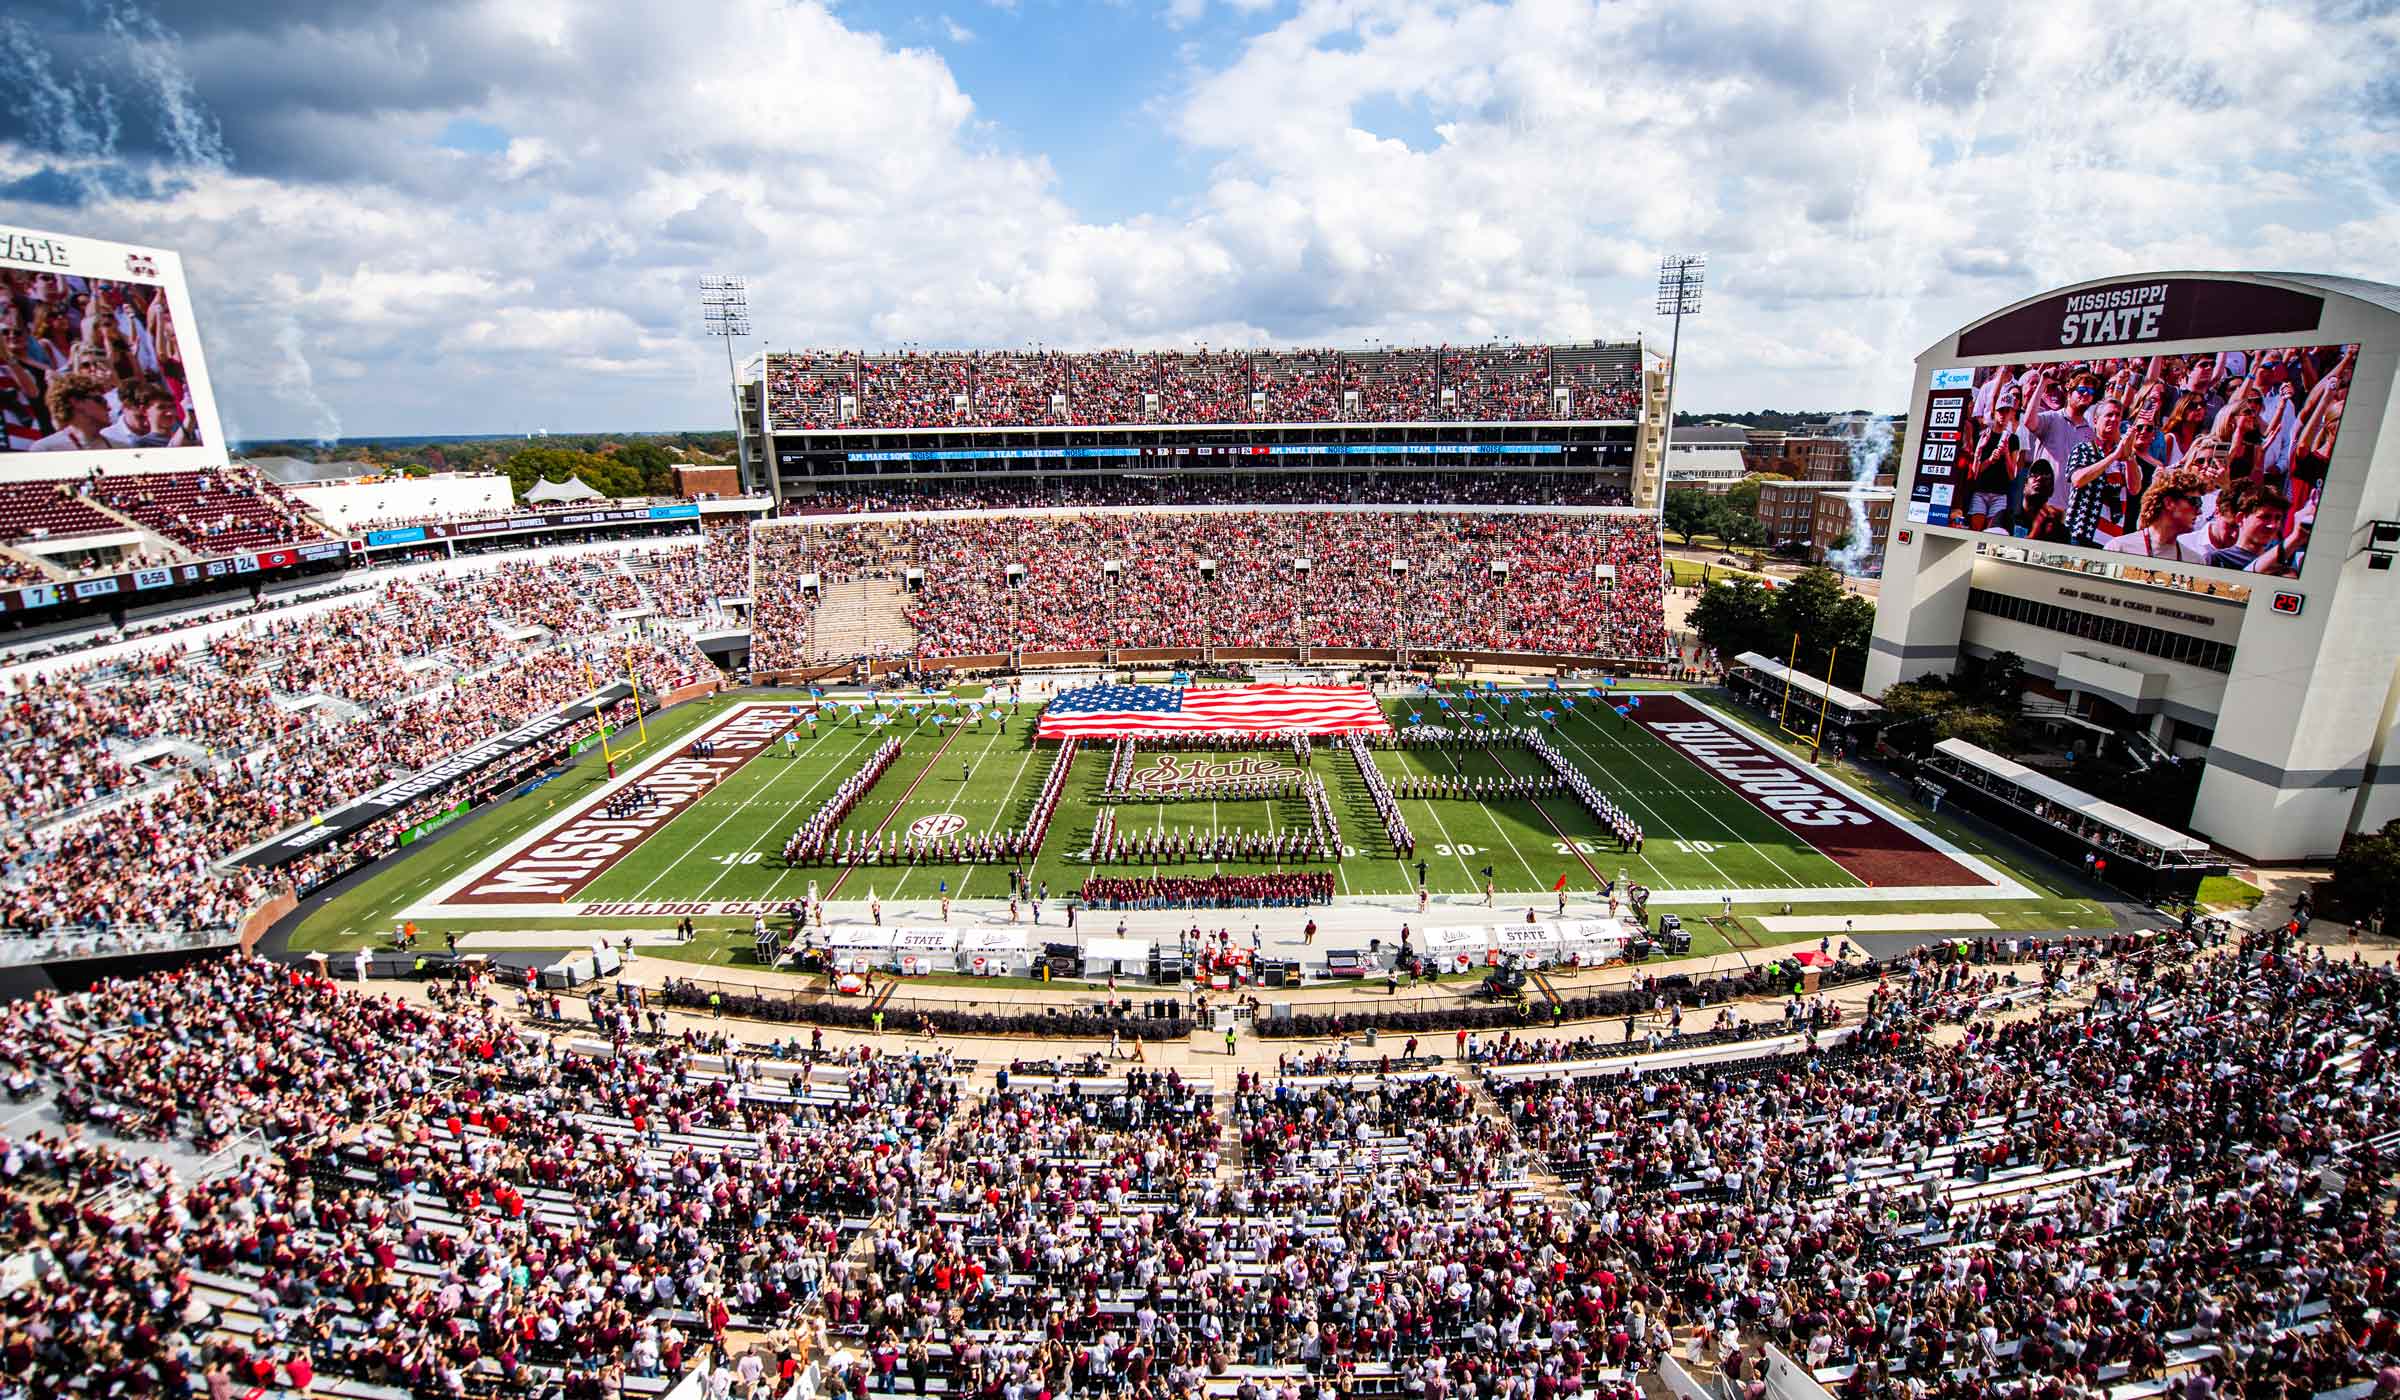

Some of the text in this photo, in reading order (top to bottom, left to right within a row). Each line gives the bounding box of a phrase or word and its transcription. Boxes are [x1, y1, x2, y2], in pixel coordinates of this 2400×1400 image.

[2065, 284, 2169, 312] MISSISSIPPI
[2060, 303, 2164, 345] STATE
[1935, 411, 1956, 424] 8:59
[1927, 446, 1954, 459] 7 24
[238, 557, 255, 570] 24
[139, 570, 166, 584] 8:59
[32, 589, 44, 603] 7
[2276, 595, 2296, 611] 25
[368, 716, 571, 807] MISSISSIPPI STATE
[1128, 756, 1304, 793] State
[1647, 721, 1873, 826] BULLDOGS
[911, 814, 966, 836] SEC
[1434, 843, 1477, 856] 30
[1552, 842, 1597, 855] 20
[1673, 840, 1717, 853] 10
[720, 852, 763, 864] 10
[577, 903, 712, 916] BULLDOG
[904, 935, 944, 945] STATE
[1506, 930, 1548, 941] STATE
